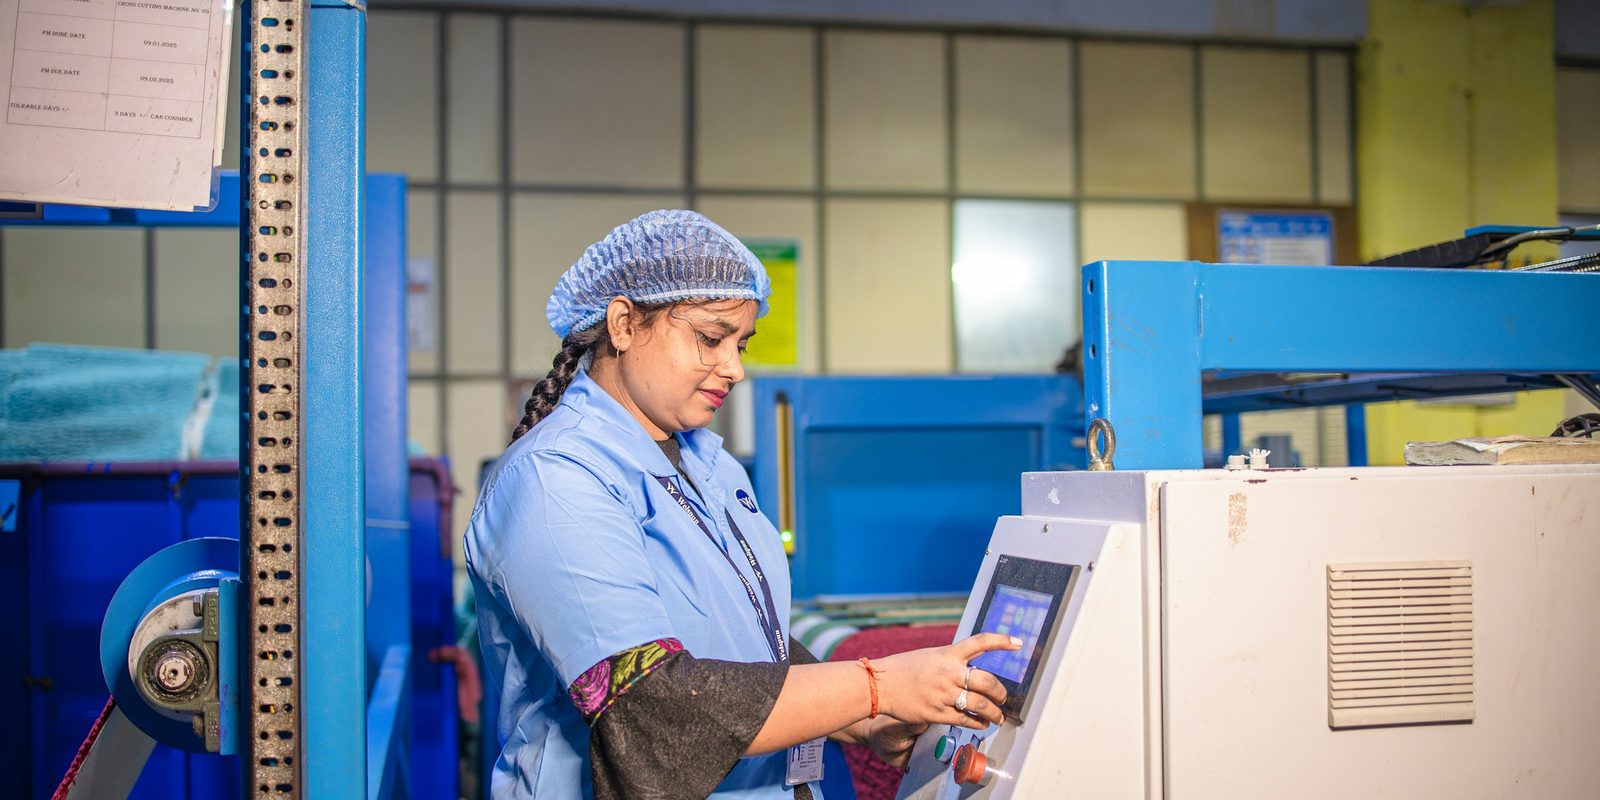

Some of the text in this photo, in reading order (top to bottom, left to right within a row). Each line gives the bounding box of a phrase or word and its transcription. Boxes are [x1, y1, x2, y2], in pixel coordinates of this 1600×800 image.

[137, 2, 162, 10] CUTTING
[143, 40, 177, 48] 09.01.2025
[140, 75, 174, 84] 09.02.2025
[678, 496, 700, 525] Welspun
[775, 629, 787, 662] Welspun
